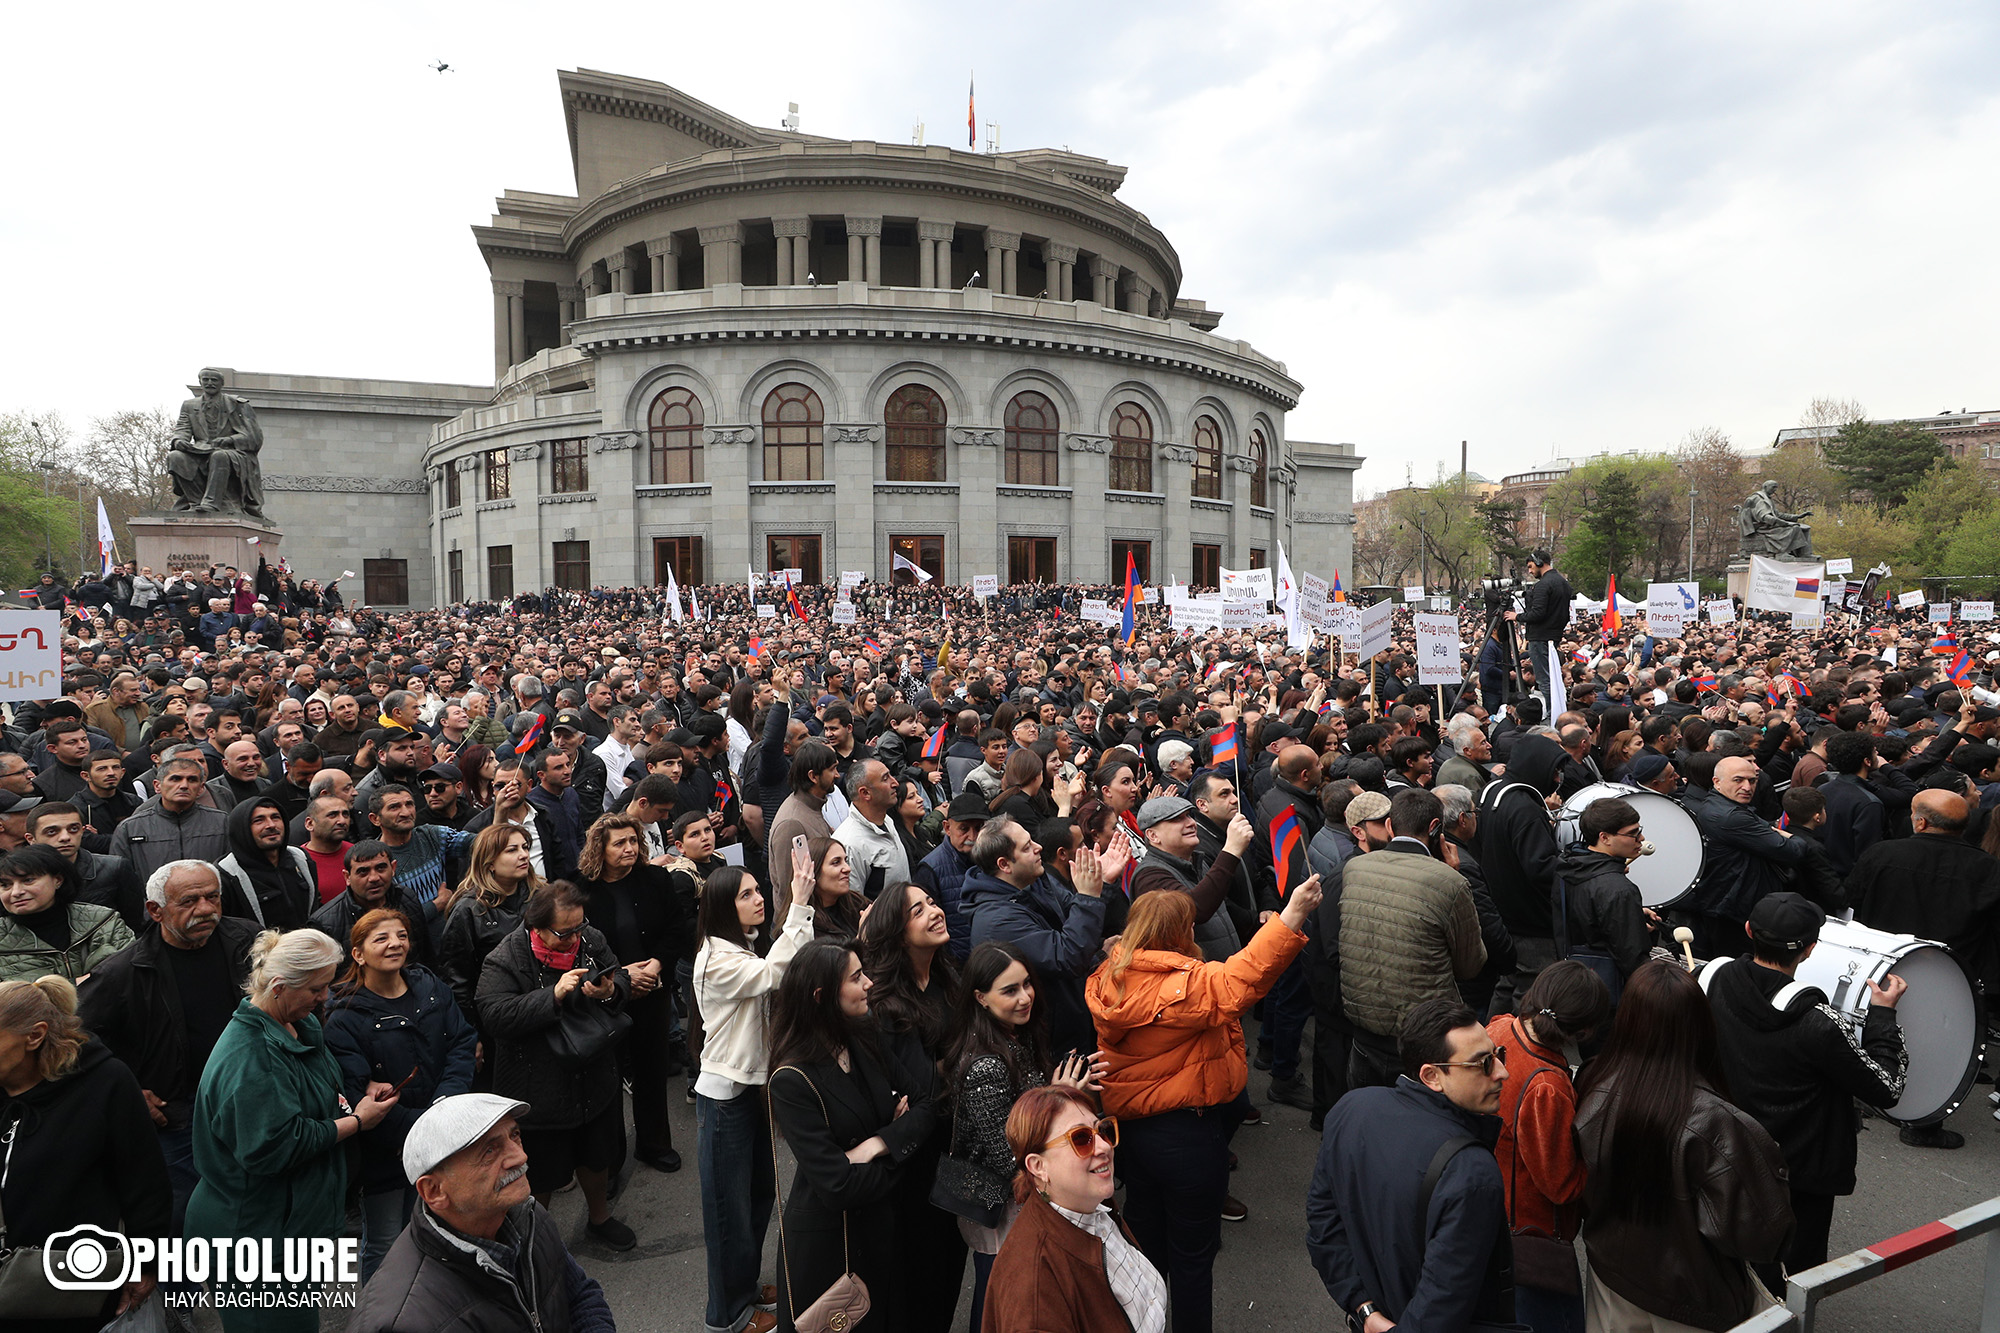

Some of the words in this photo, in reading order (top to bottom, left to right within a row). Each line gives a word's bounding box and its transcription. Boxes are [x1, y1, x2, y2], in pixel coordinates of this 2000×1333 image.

[1246, 573, 1267, 583] ՈՒԺԵՂ
[1081, 602, 1105, 610] ՈՒԺԵՂ
[1224, 608, 1251, 616] ՈՒԺԵՂ
[1651, 612, 1680, 622] ՈՒԺԵՂ
[1432, 642, 1448, 657] չենք
